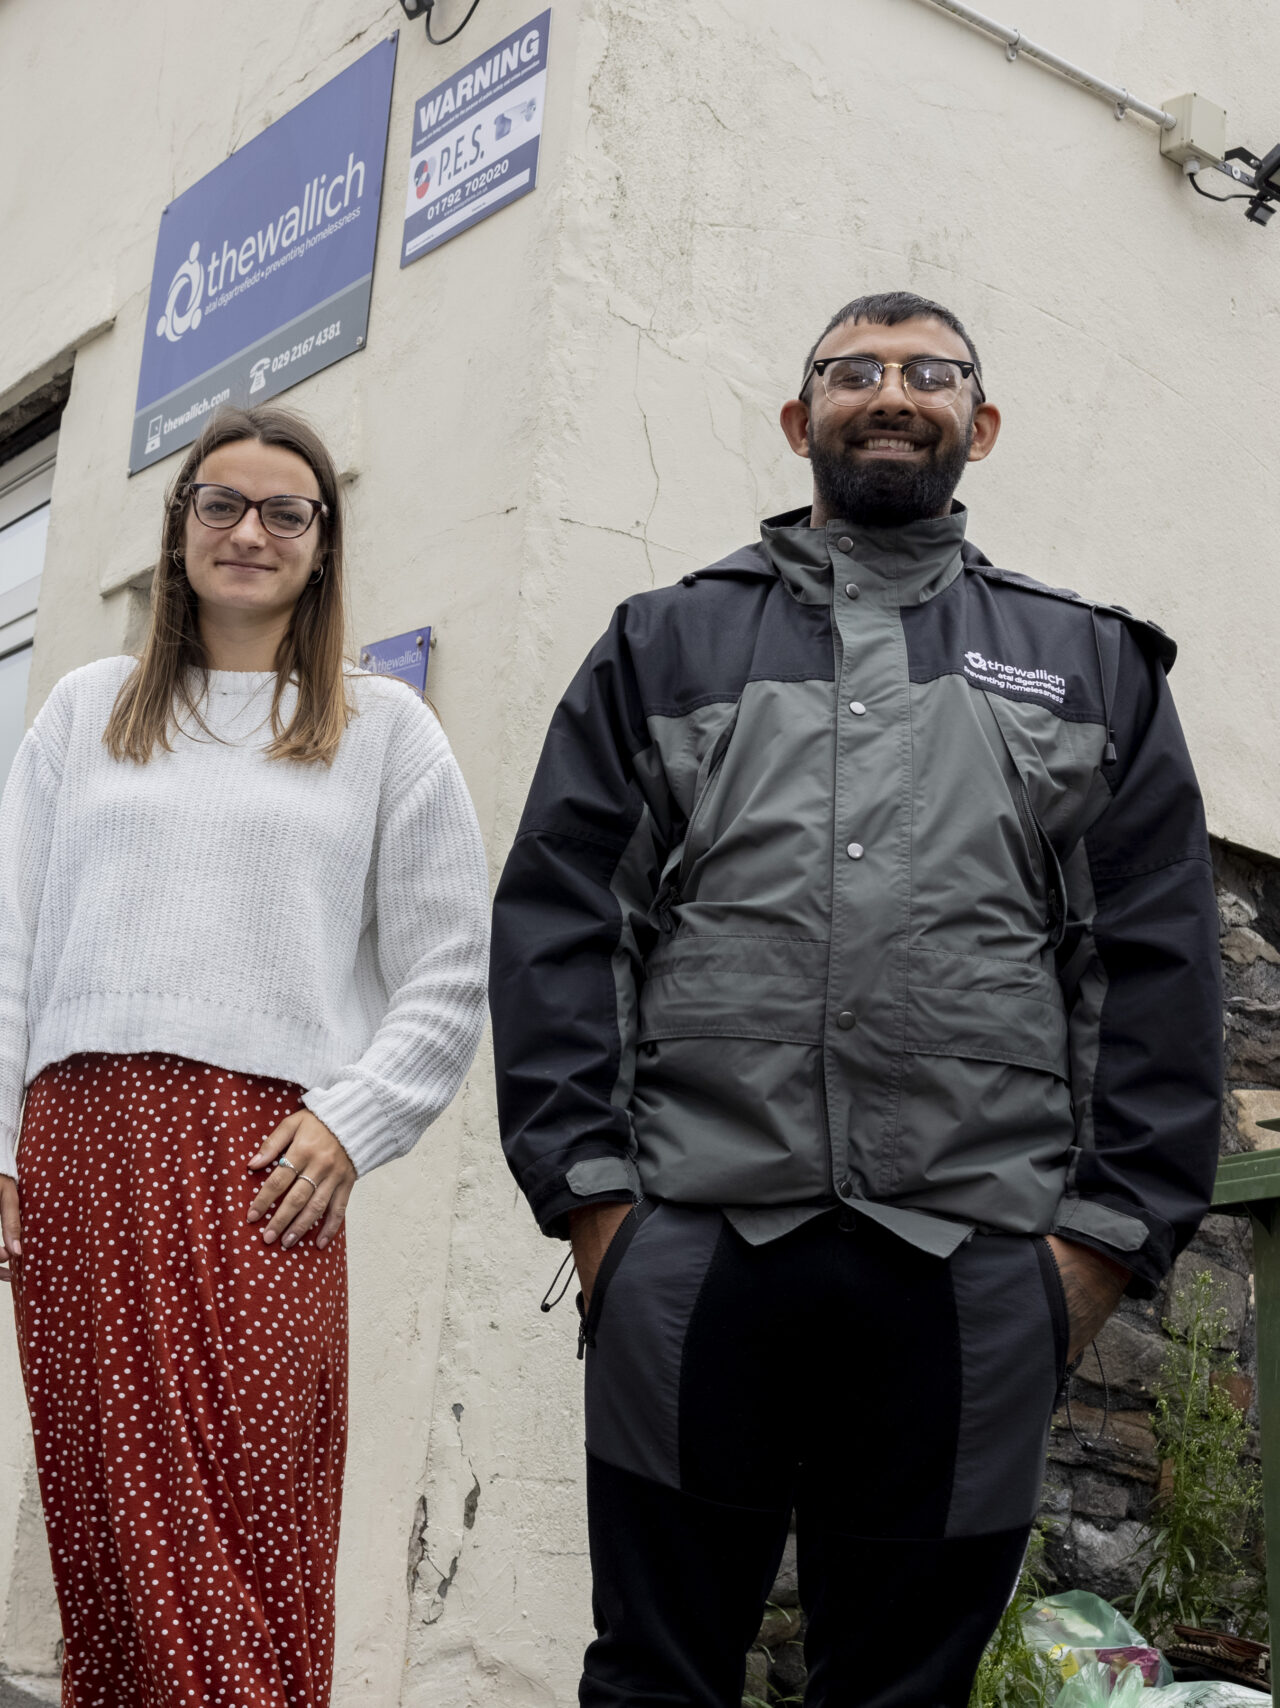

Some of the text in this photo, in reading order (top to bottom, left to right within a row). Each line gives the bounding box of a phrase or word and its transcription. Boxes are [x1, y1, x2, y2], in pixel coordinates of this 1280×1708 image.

[420, 29, 540, 133] WARNING
[438, 123, 484, 187] P.E.S.
[427, 188, 462, 221] 01792
[465, 159, 509, 197] 702020
[207, 151, 366, 297] thewallich
[204, 297, 218, 316] atal
[264, 242, 306, 280] preventing
[305, 206, 361, 250] homelessness
[271, 319, 342, 373] 029 2167 4381
[163, 387, 231, 435] thewallich.com
[377, 648, 423, 674] thewallich
[987, 660, 1066, 687] thewallich
